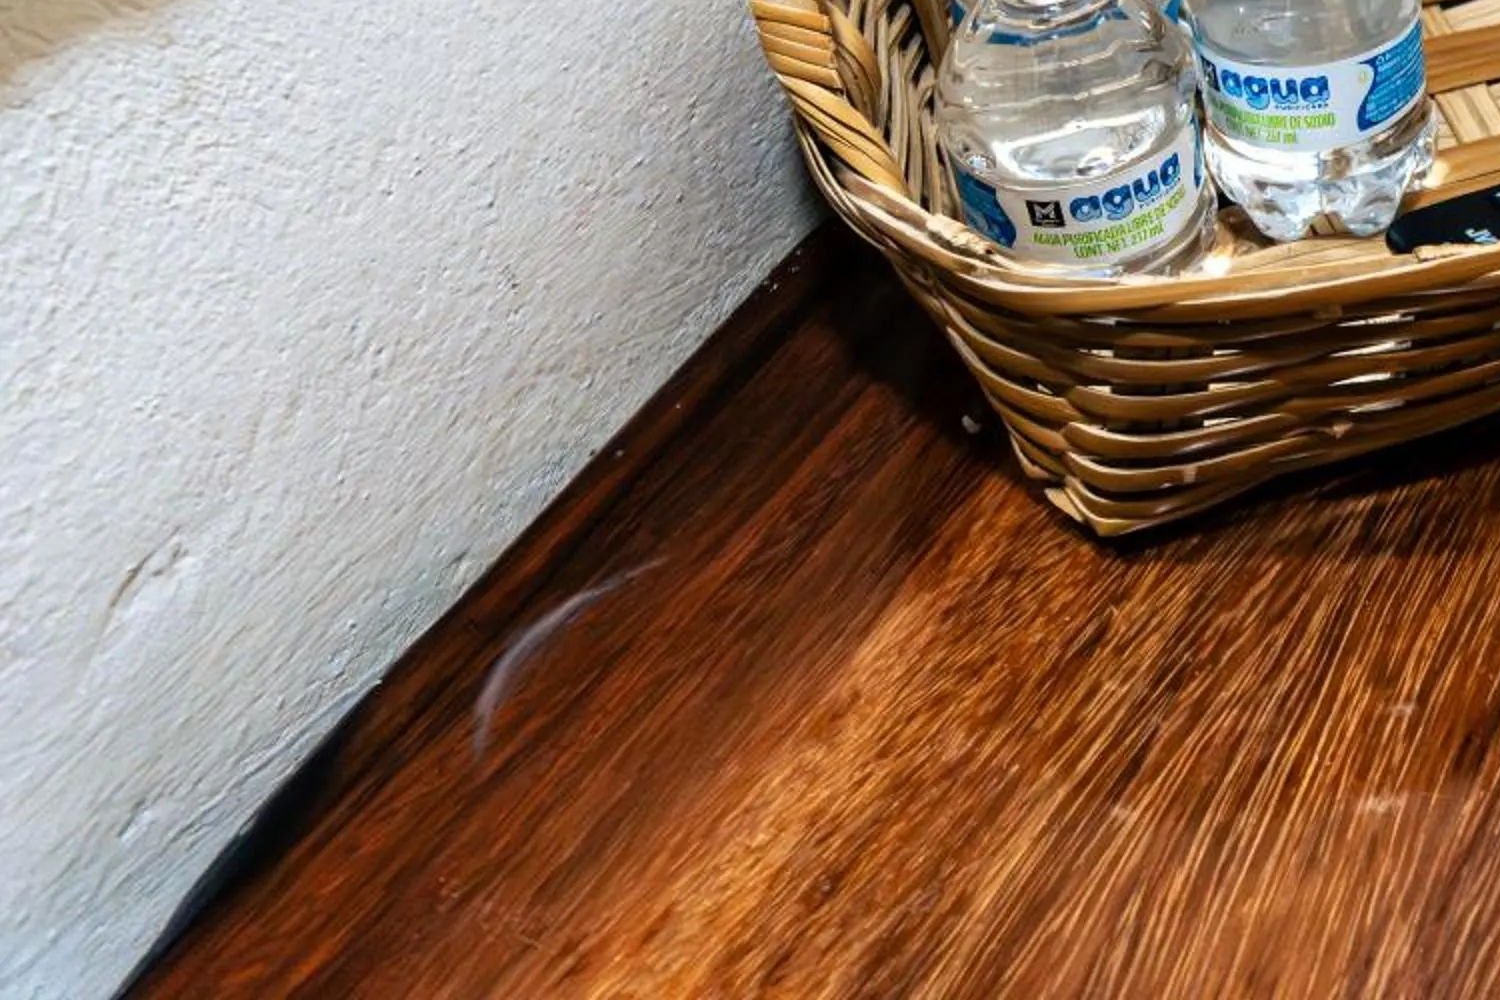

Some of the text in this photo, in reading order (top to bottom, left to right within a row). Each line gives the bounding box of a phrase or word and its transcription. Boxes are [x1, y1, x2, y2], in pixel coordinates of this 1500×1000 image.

[1221, 69, 1331, 111] agua
[1069, 152, 1181, 222] agua
[1464, 228, 1498, 244] JV
